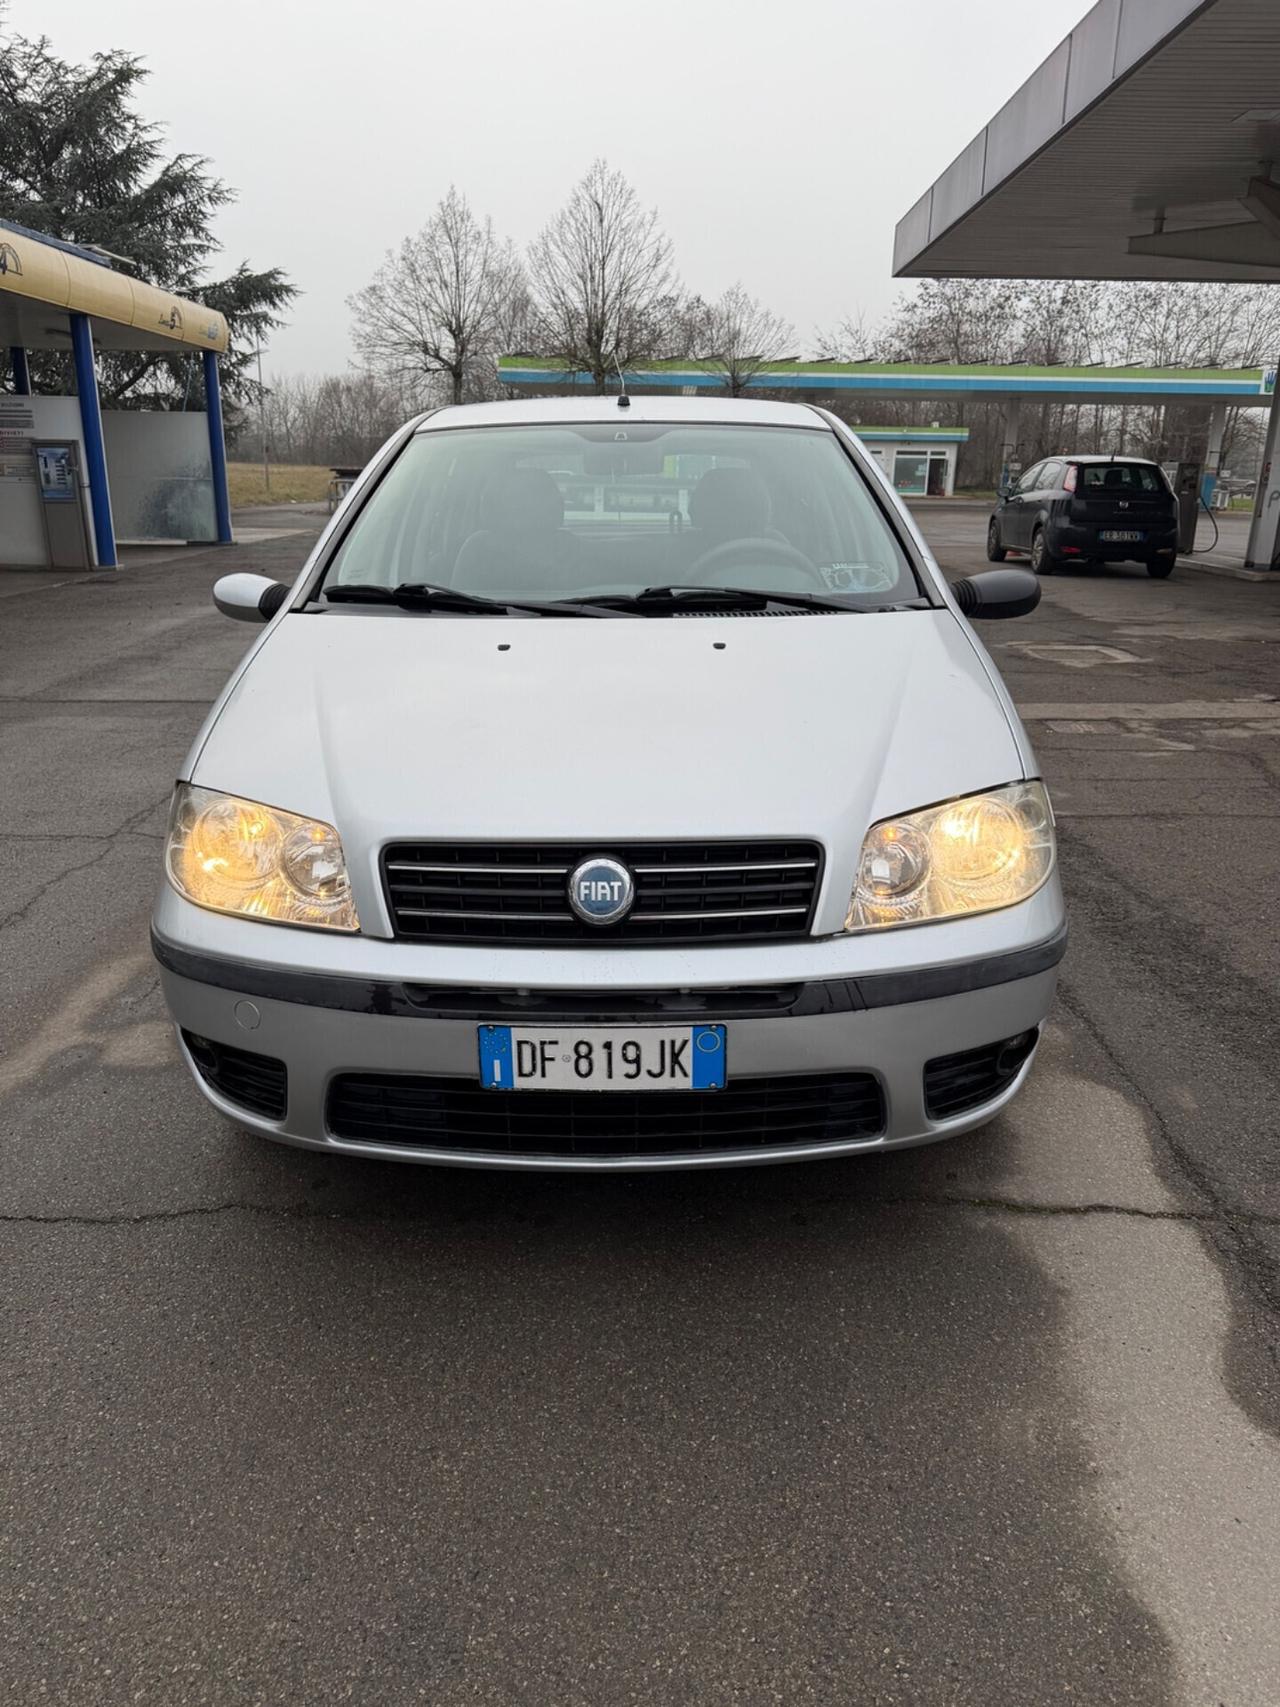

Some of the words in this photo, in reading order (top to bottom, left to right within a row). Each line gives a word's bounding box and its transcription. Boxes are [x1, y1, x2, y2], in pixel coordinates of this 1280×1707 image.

[580, 881, 622, 901] FIAT
[516, 1040, 559, 1078] DF
[573, 1039, 690, 1080] 819JK
